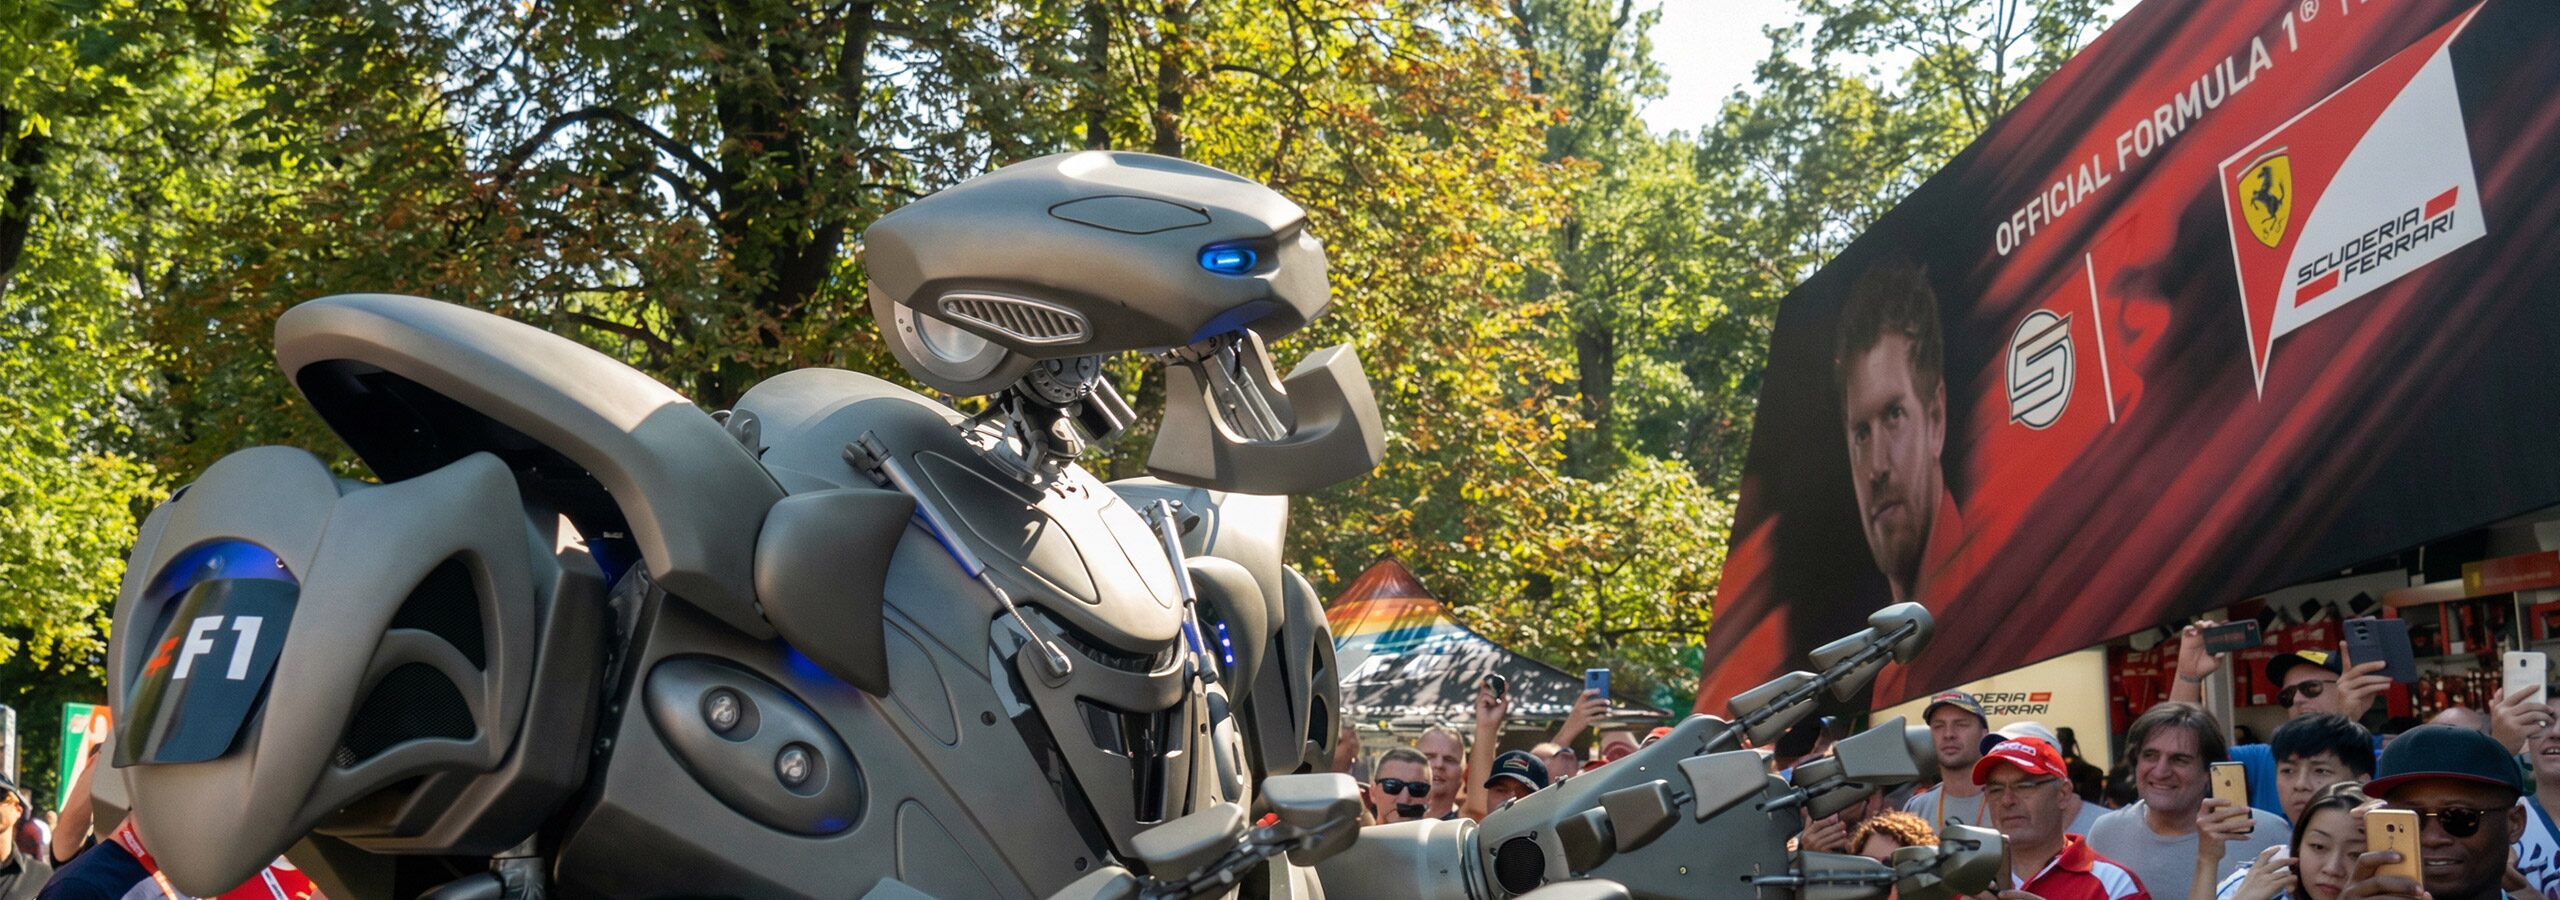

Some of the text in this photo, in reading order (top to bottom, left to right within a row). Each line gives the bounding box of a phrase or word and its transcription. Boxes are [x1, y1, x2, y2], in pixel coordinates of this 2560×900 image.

[1996, 154, 2111, 256] OFFICIAL
[2116, 36, 2273, 172] FORMULA
[2297, 207, 2420, 286] SCUDERIA
[2344, 210, 2455, 283] FERRARI
[1972, 692, 2026, 704] DERIA
[1983, 704, 2048, 716] ERRARI
